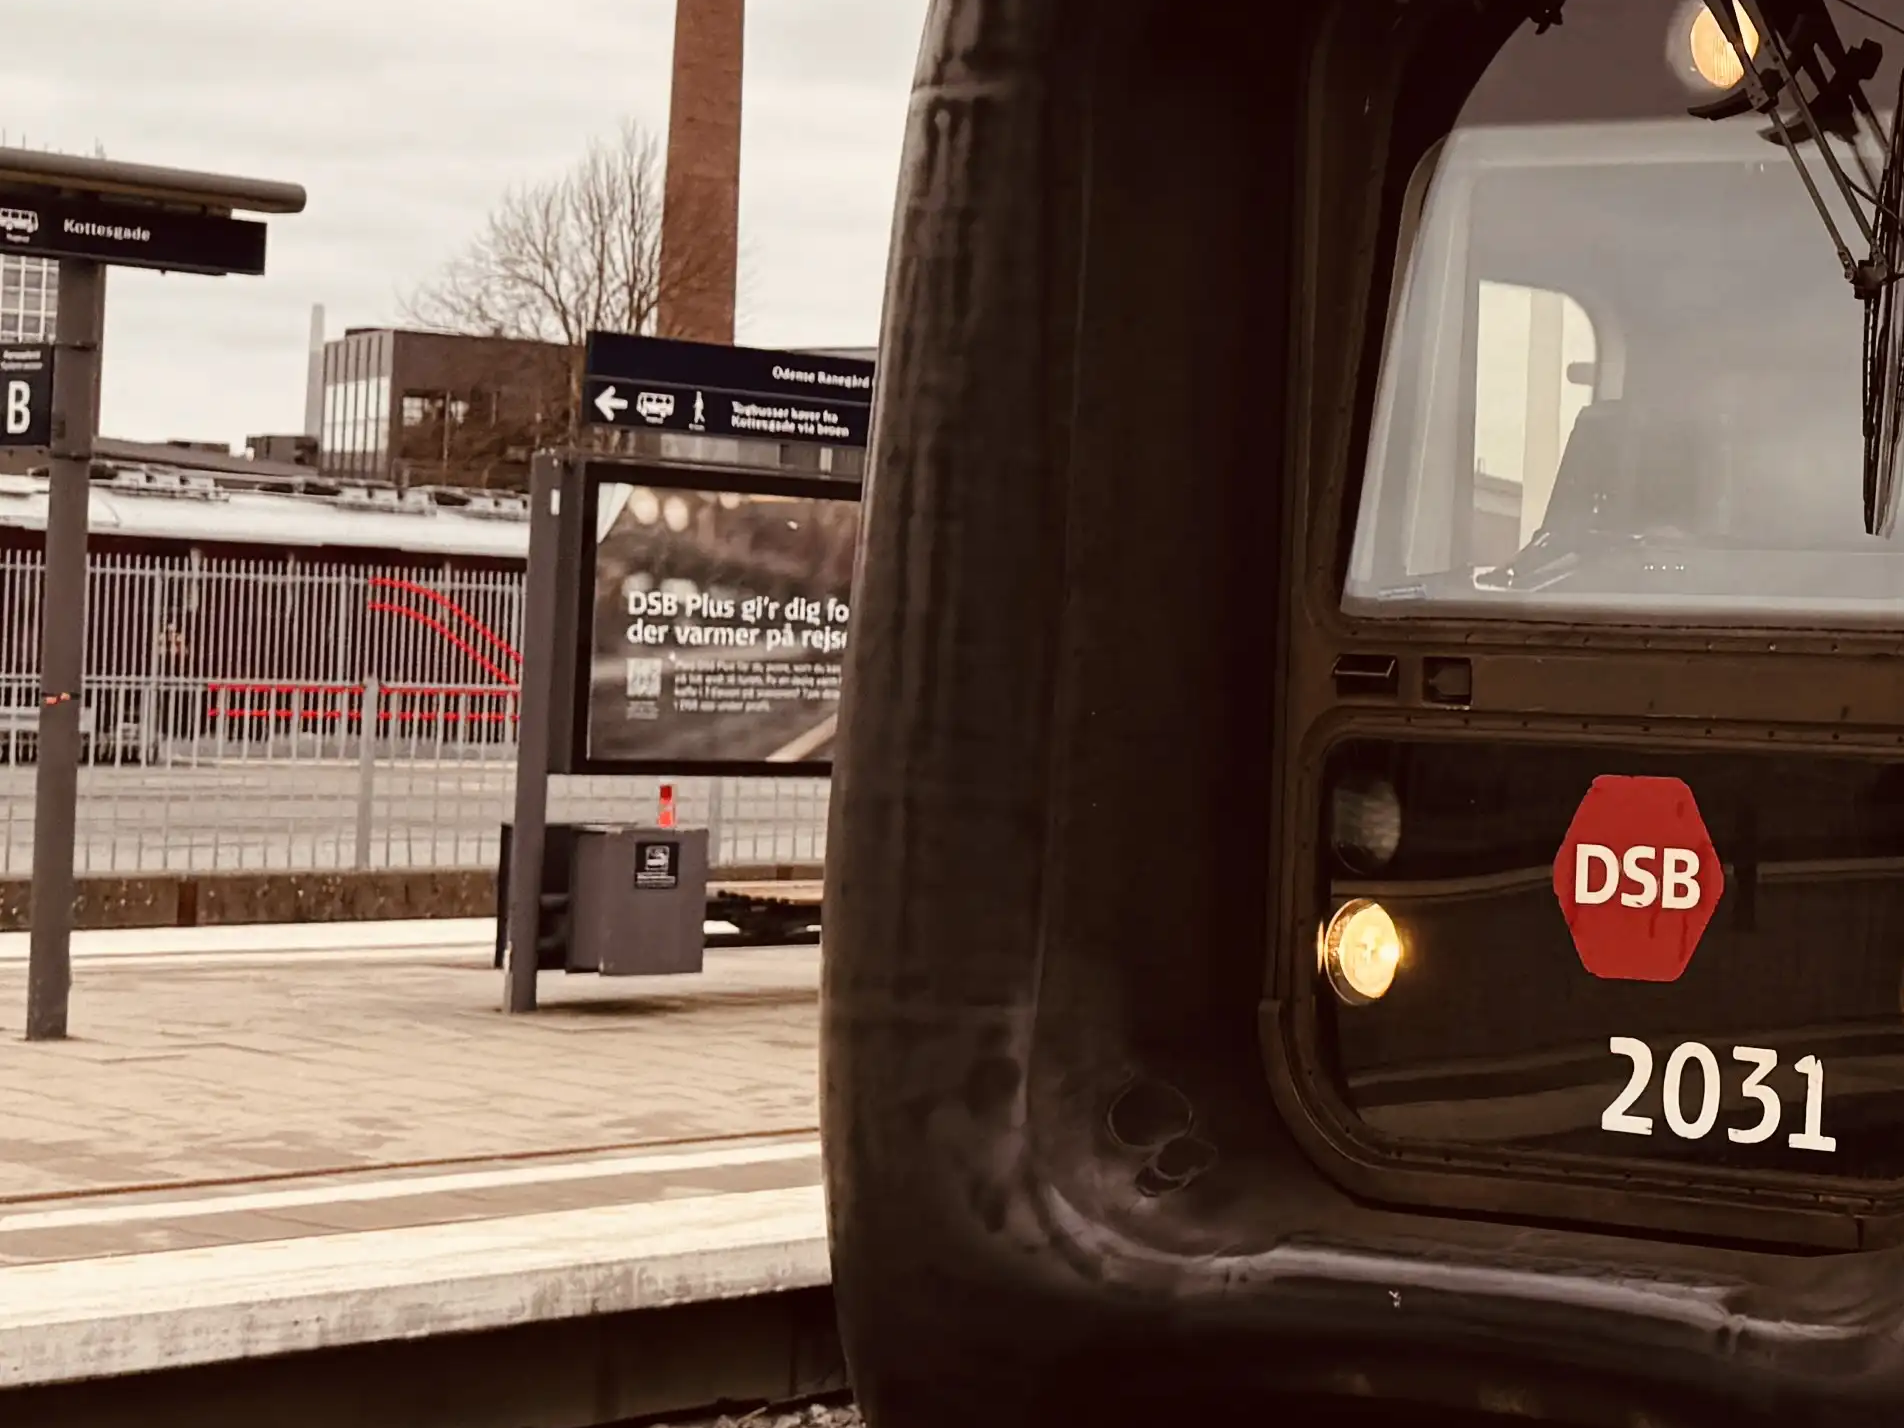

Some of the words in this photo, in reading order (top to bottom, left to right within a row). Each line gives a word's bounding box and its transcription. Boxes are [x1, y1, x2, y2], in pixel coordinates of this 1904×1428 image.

[64, 218, 151, 242] Kottesgade
[6, 380, 31, 434] B
[628, 591, 679, 616] DSB
[685, 592, 736, 618] Plus
[785, 596, 821, 625] dig
[626, 618, 669, 645] der
[675, 623, 760, 646] varmer
[766, 622, 794, 651] på
[1575, 843, 1701, 909] DSB
[1601, 1036, 1837, 1152] 2031
